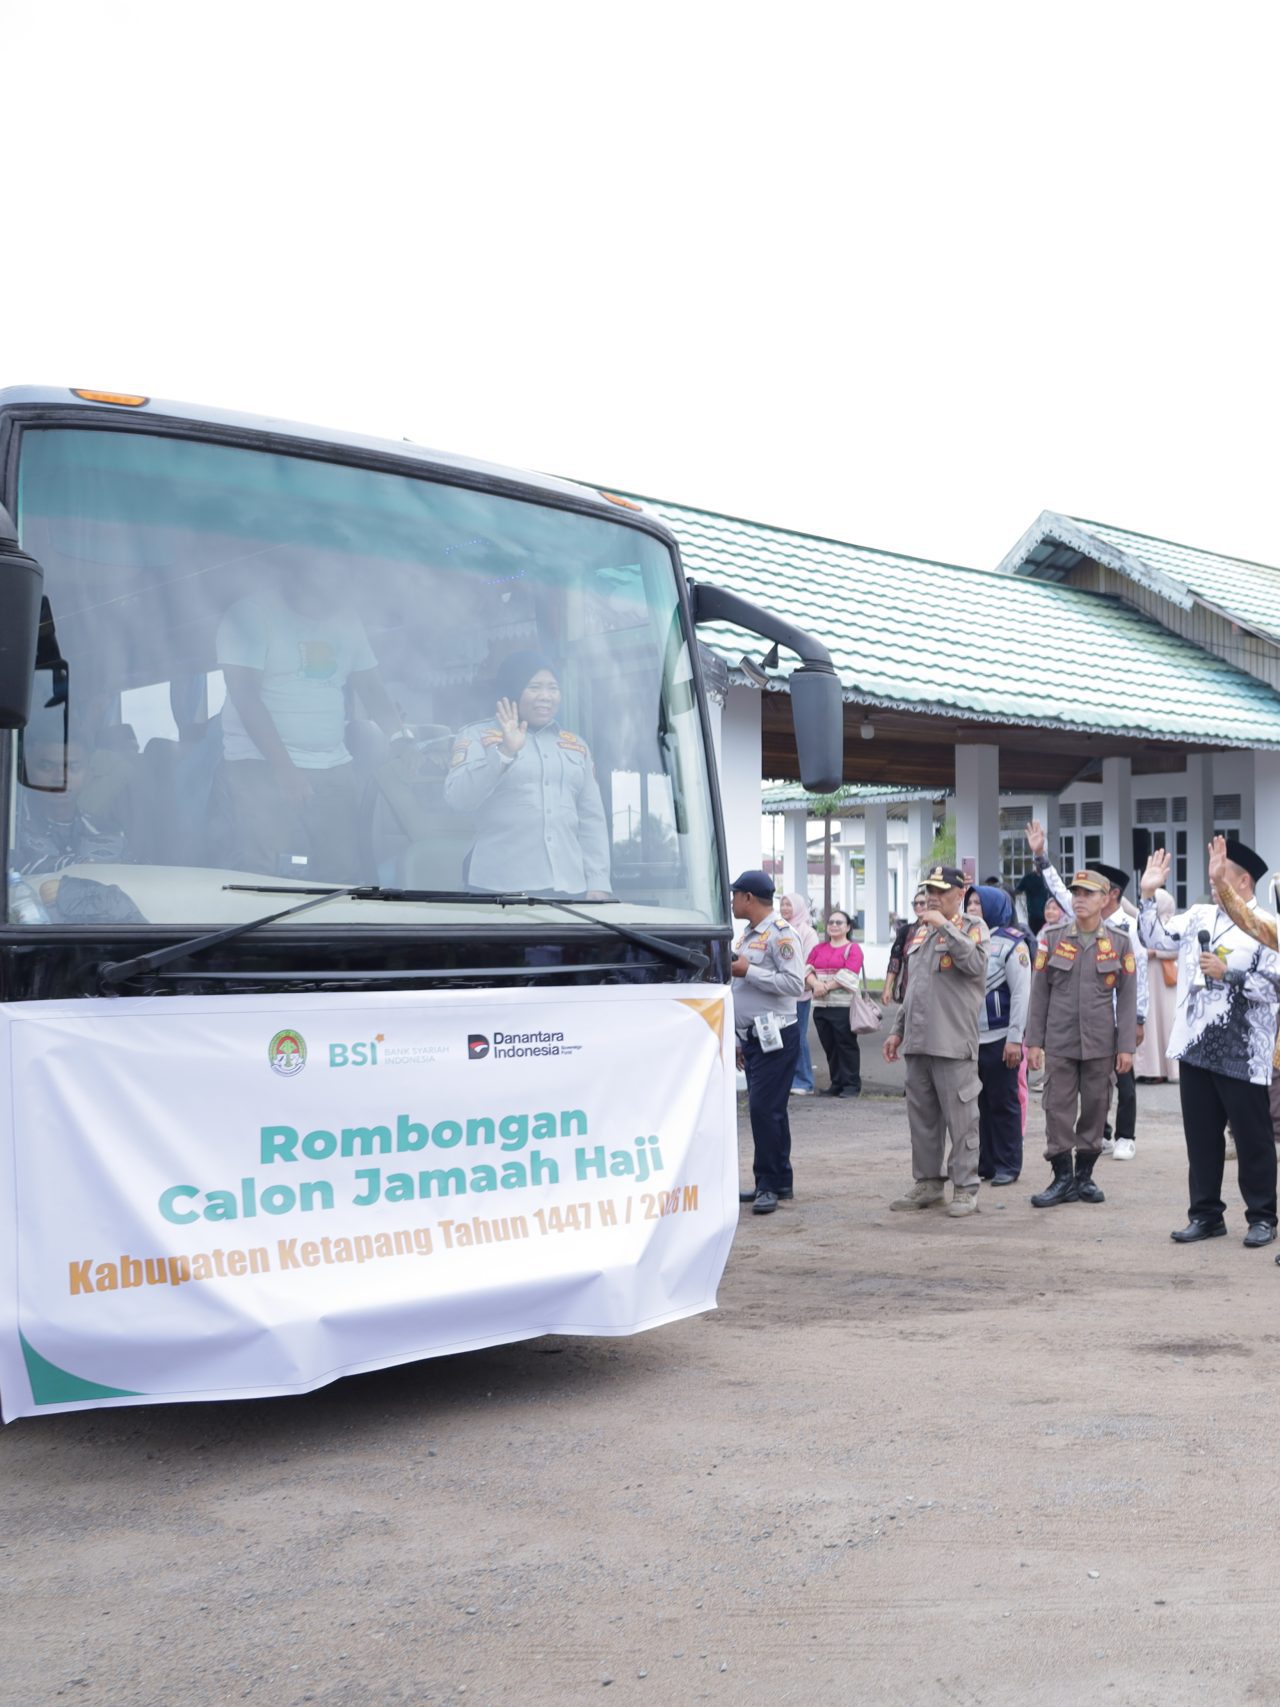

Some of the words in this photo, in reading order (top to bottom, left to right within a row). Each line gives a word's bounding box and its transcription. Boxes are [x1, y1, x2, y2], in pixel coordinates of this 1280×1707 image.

[493, 1031, 564, 1045] Danantara
[329, 1041, 378, 1068] BSI
[384, 1048, 410, 1056] BANK
[412, 1045, 450, 1055] SYARIAH
[384, 1055, 436, 1065] INDONESIA
[494, 1043, 560, 1059] Indonesia
[260, 1108, 588, 1165] Rombongan
[158, 1176, 335, 1226] Calon
[352, 1149, 560, 1207] Jamaah
[575, 1135, 665, 1183] Haji
[69, 1244, 272, 1296] Kabupaten
[276, 1226, 434, 1271] Ketapang
[438, 1213, 530, 1249] Tahun
[533, 1201, 592, 1236] 1447
[597, 1198, 617, 1228] H
[625, 1195, 633, 1225] /
[682, 1184, 698, 1213] M
